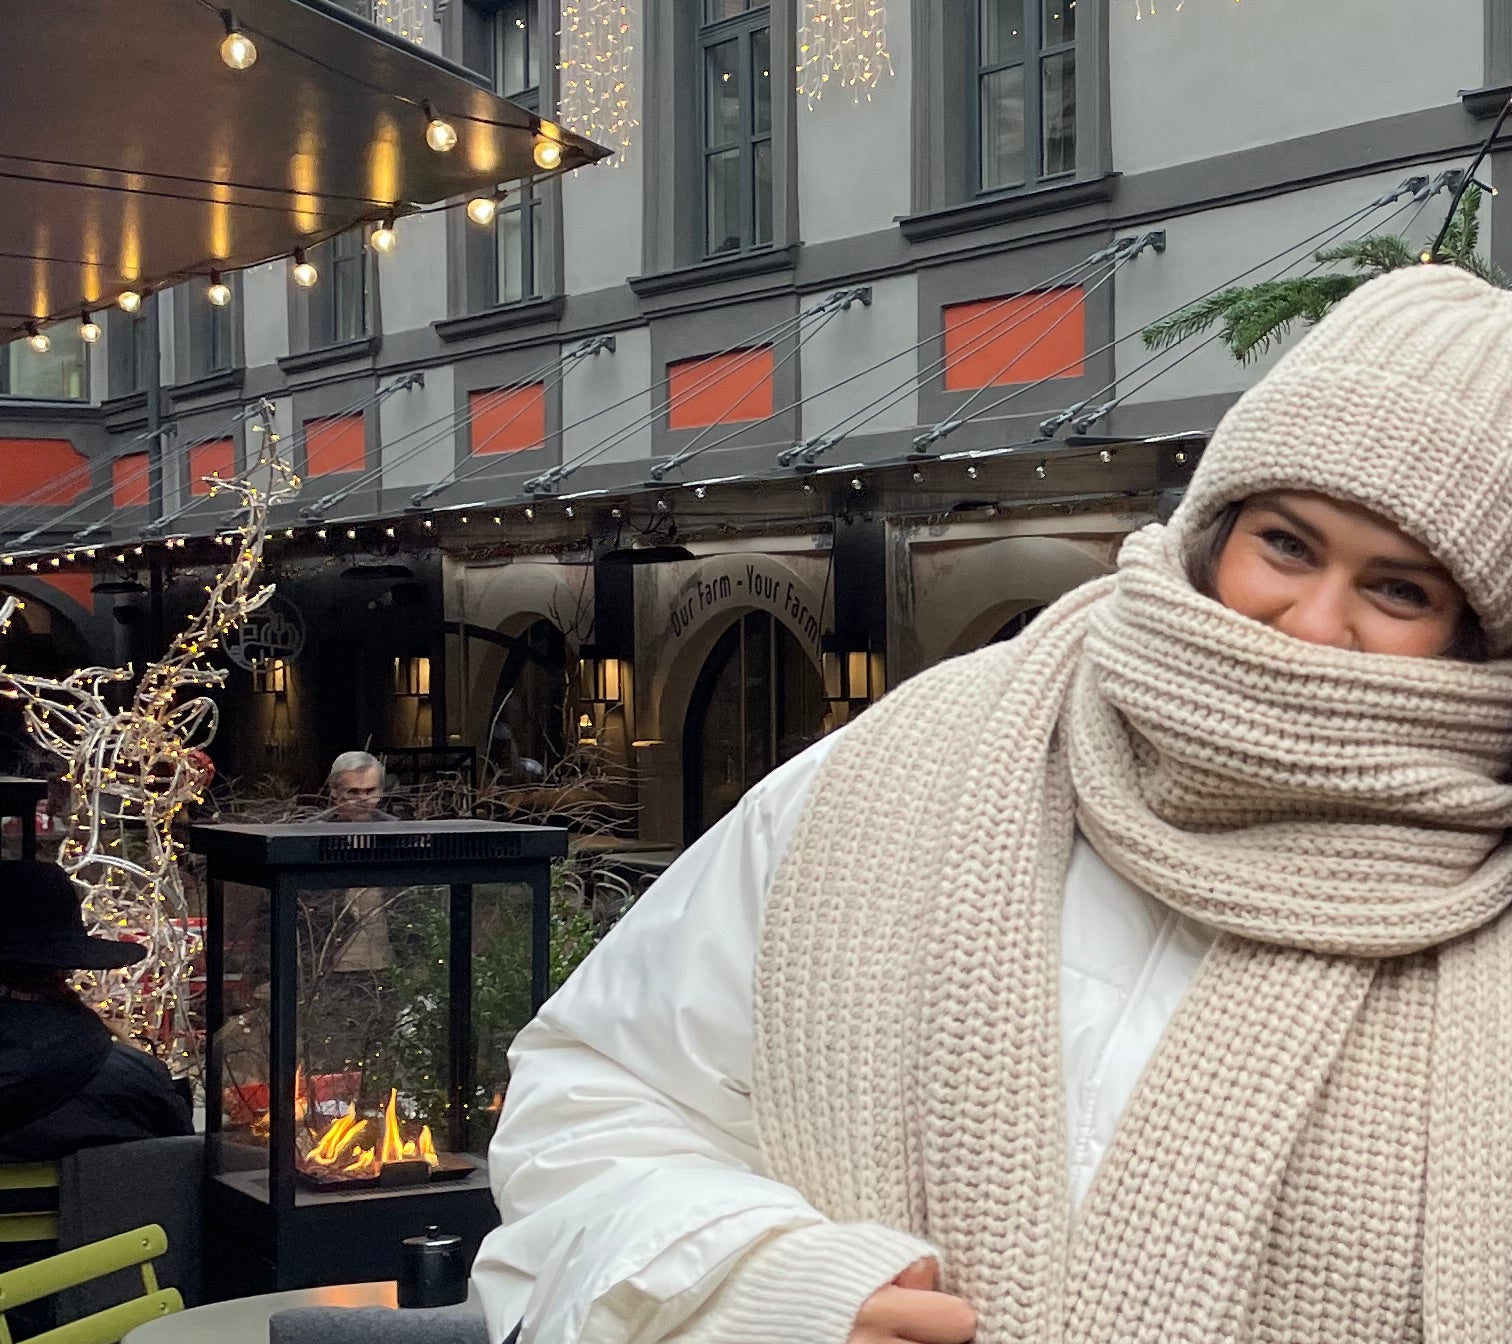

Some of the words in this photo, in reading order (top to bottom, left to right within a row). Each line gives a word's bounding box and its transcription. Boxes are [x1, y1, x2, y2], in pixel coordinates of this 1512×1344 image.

[671, 598, 694, 637] Our
[697, 574, 732, 611] Farm
[746, 564, 780, 603] Your
[785, 582, 818, 643] Farm
